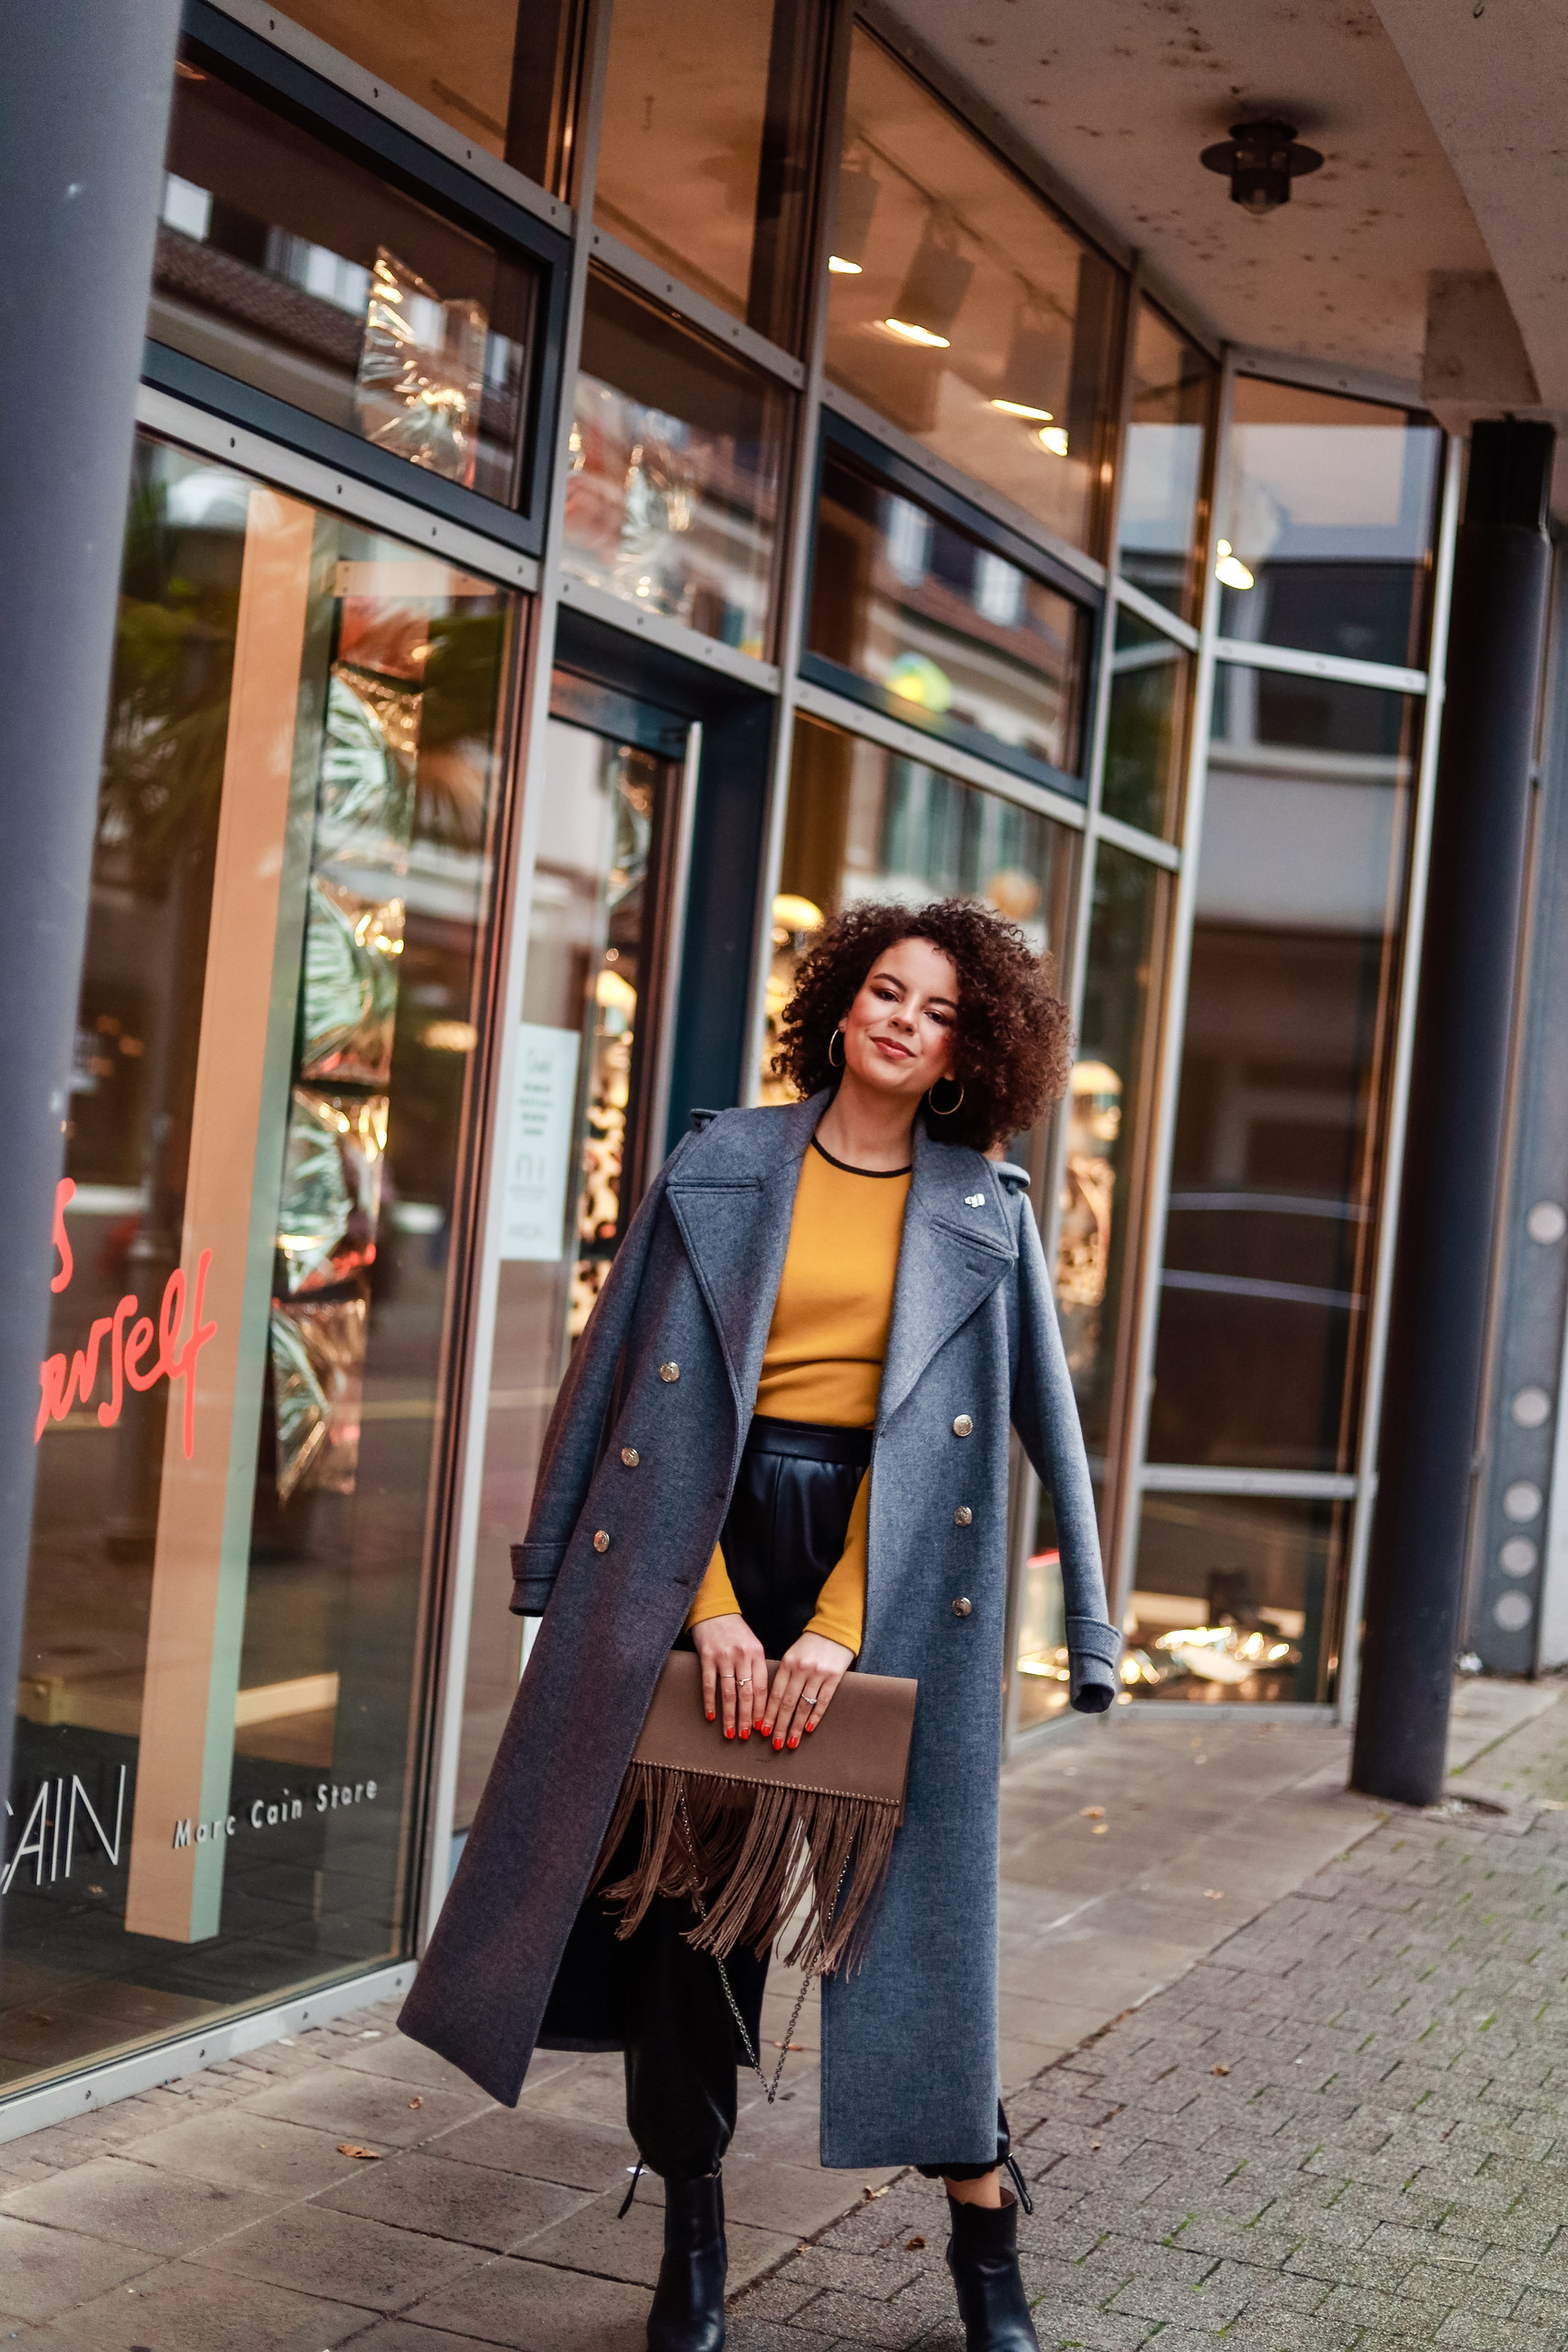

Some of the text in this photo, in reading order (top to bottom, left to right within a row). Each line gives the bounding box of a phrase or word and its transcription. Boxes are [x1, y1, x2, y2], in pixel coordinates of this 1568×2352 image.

[0, 1764, 126, 1895] AIN
[173, 1780, 378, 1849] Marc Cain Store
